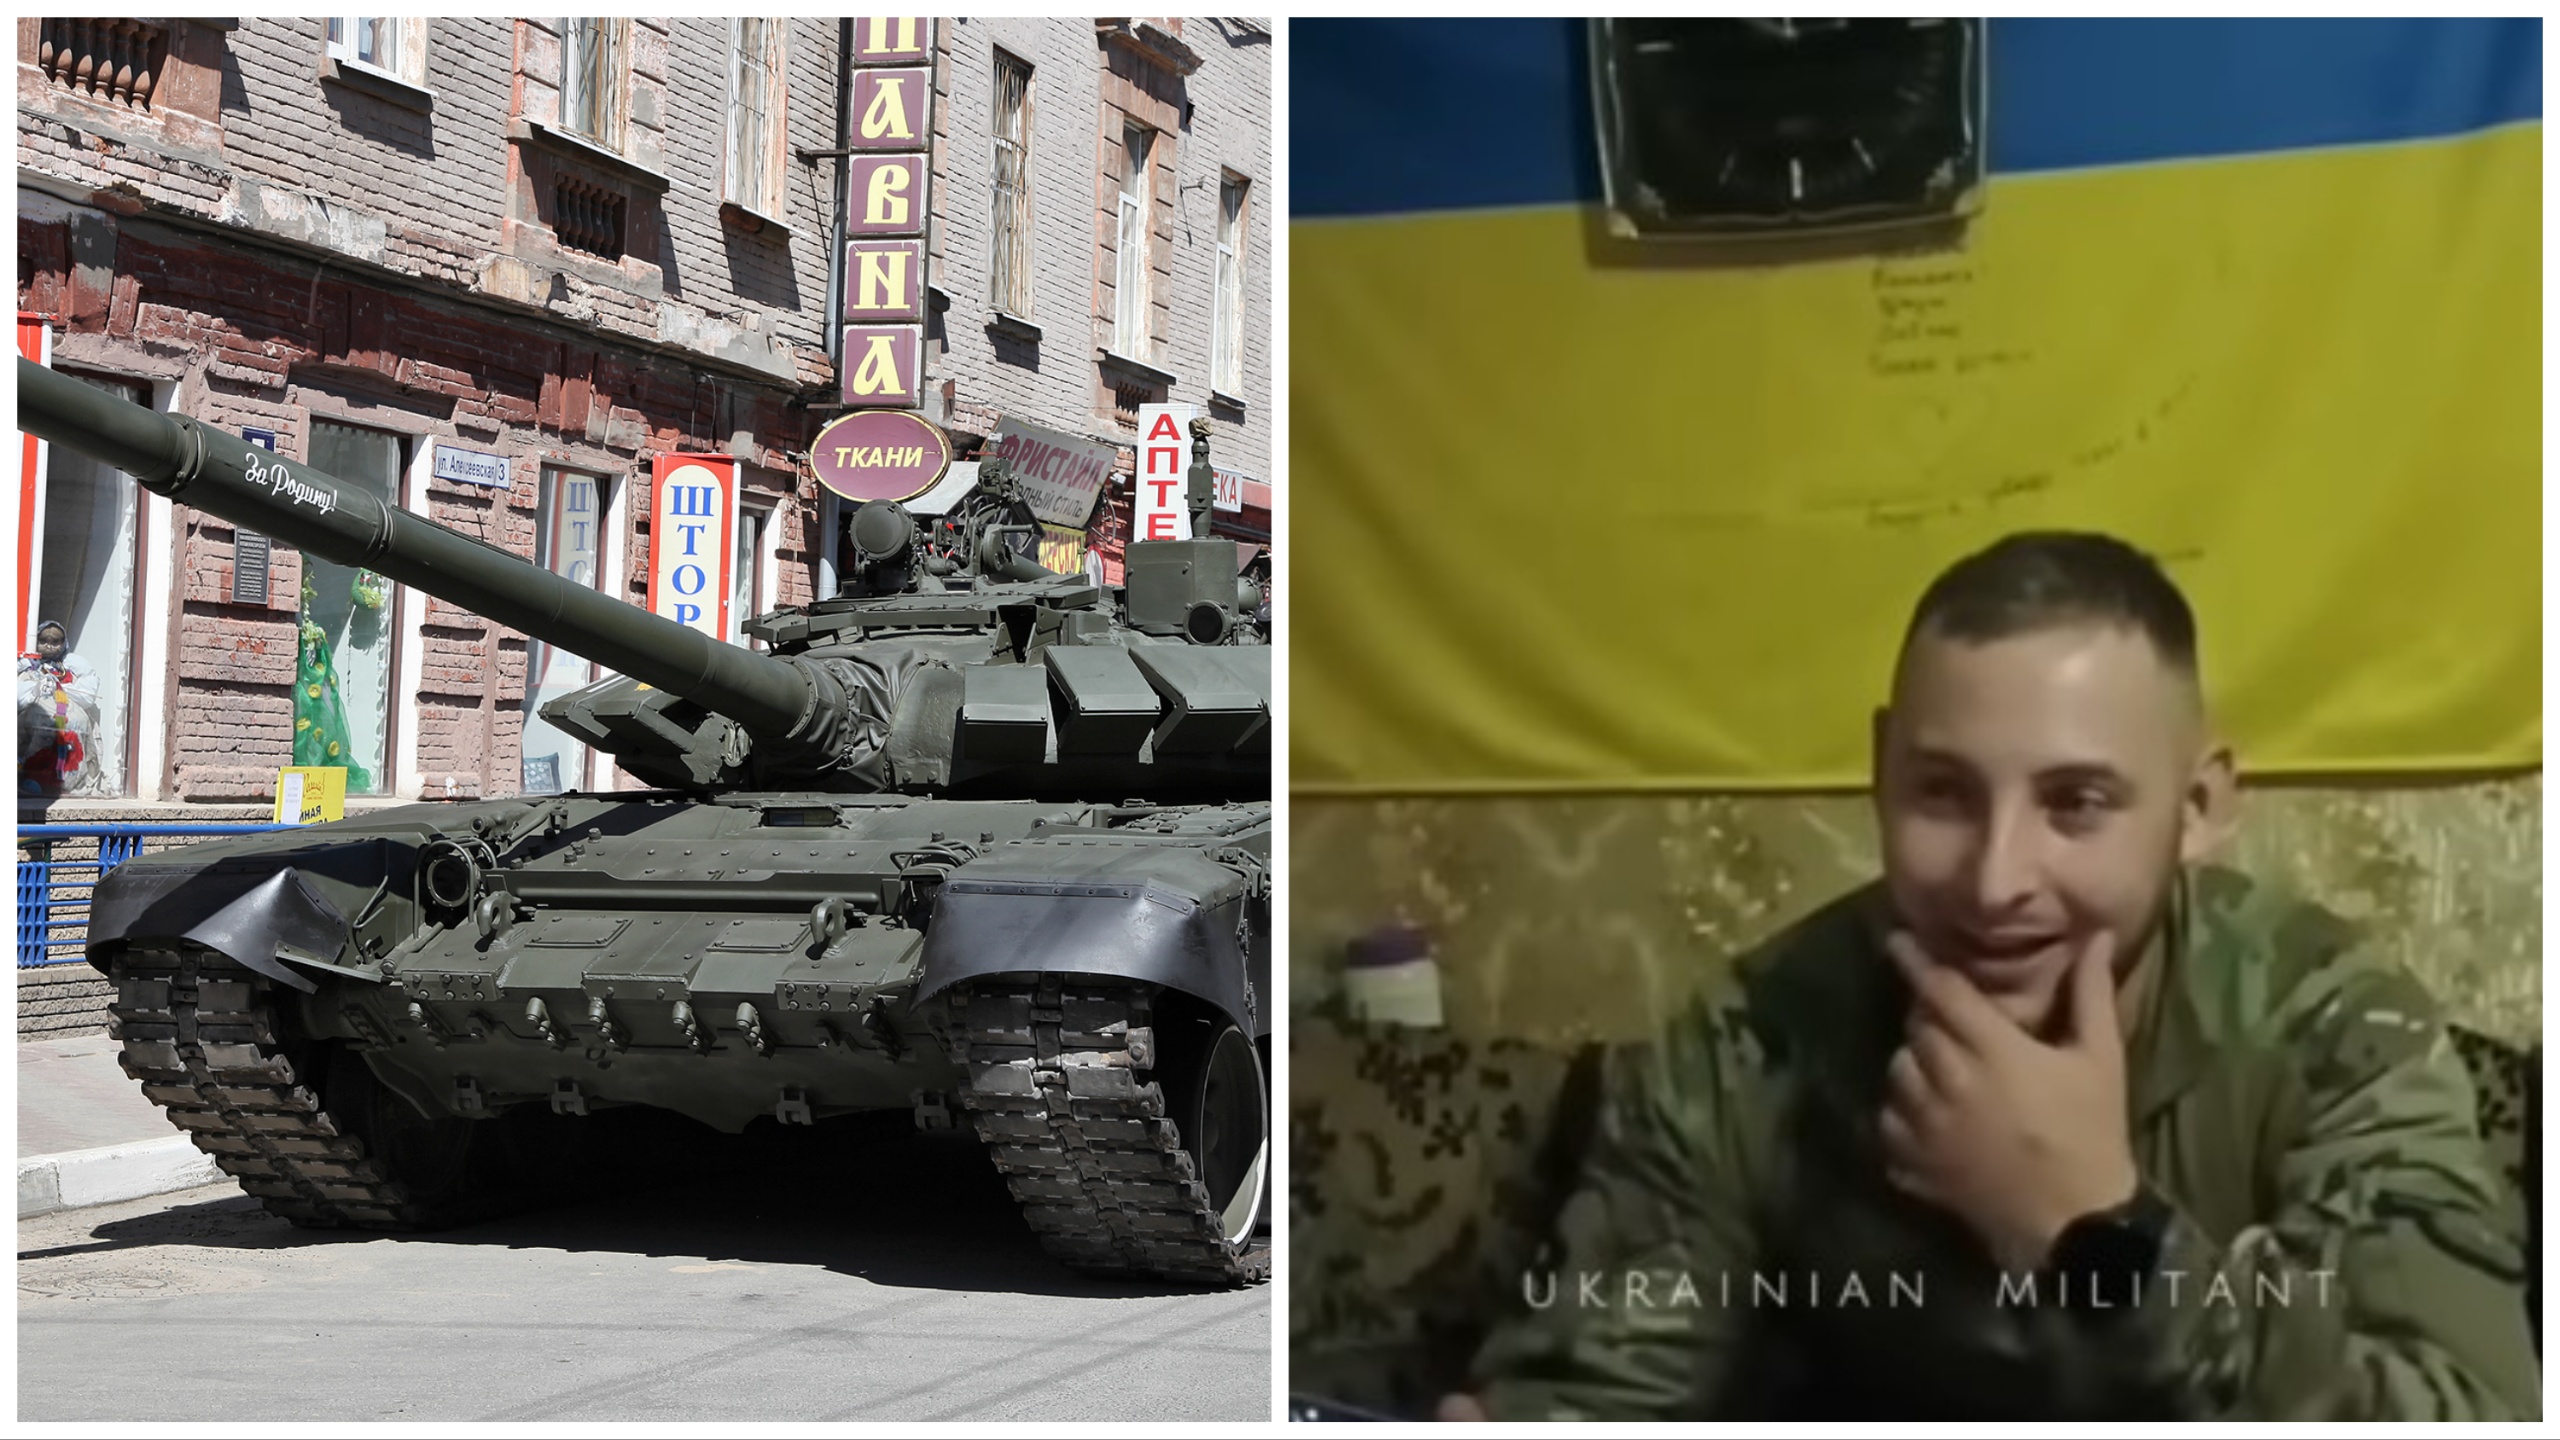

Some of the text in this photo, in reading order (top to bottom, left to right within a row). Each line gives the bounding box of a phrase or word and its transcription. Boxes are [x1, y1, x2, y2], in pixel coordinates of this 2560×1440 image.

[437, 456, 448, 475] ул.
[498, 463, 506, 481] 3
[835, 446, 924, 468] ТКАНИ
[997, 434, 1105, 492] ФРИСТАЙЛ
[245, 452, 338, 515] За Родину!
[1053, 495, 1084, 518] СТИЛЬ
[669, 485, 716, 626] ШТОР
